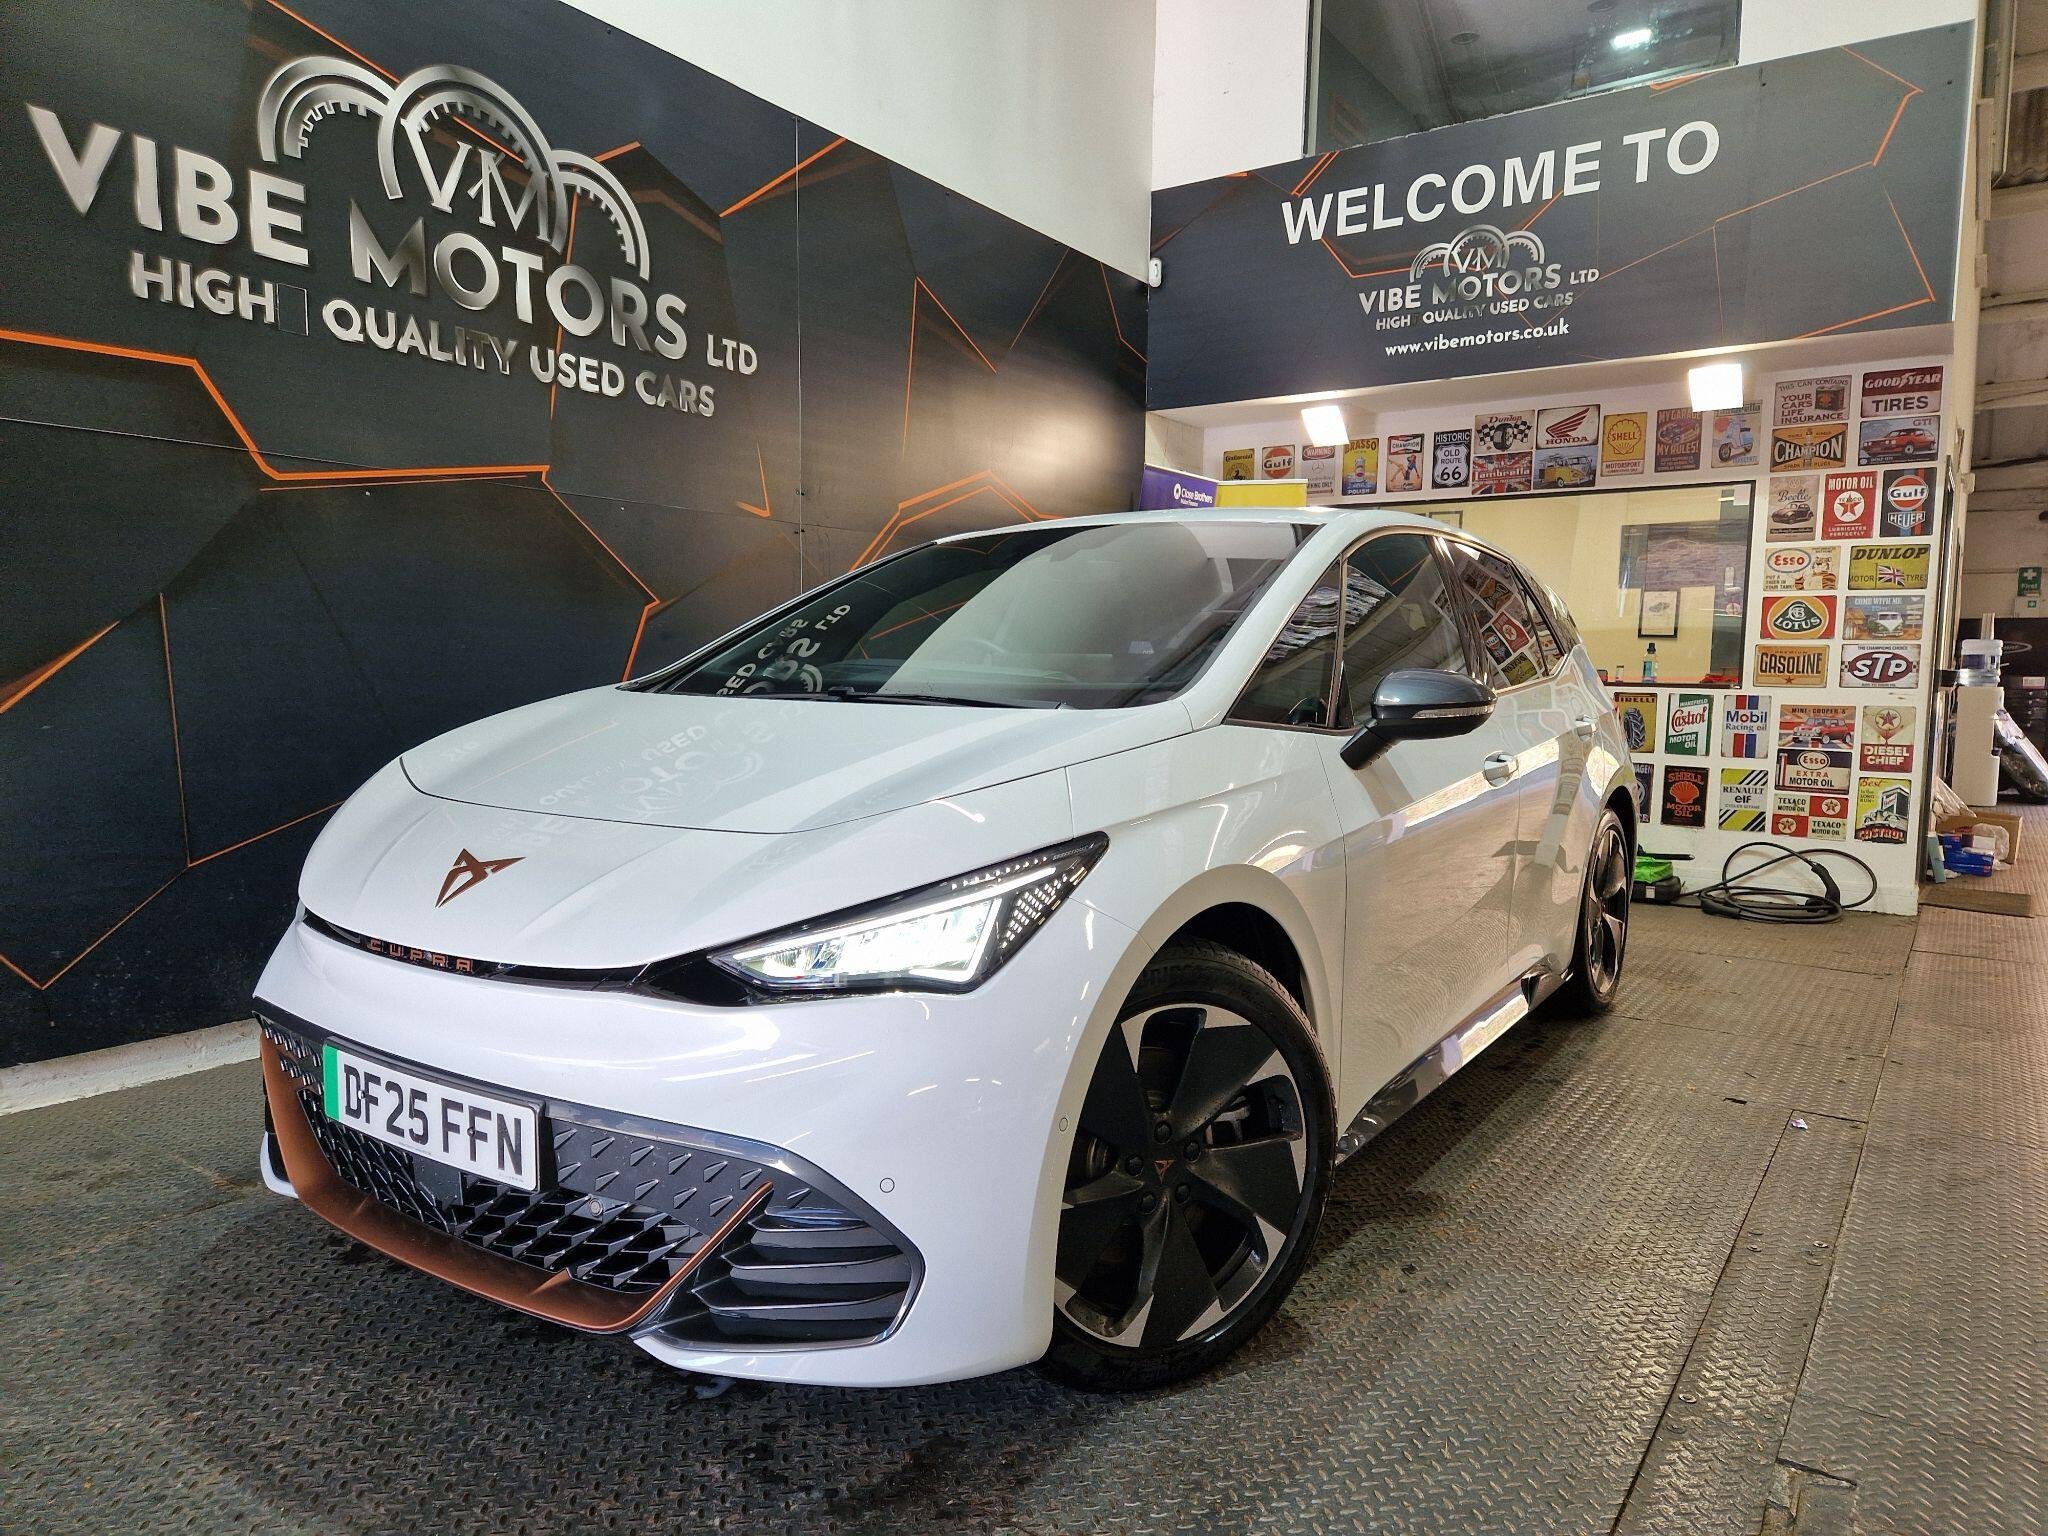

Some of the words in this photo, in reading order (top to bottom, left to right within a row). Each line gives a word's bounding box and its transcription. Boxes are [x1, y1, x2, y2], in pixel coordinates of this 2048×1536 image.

[1281, 139, 1602, 246] WELCOME
[1622, 120, 1720, 183] TO
[26, 102, 310, 266] VIBE
[350, 199, 688, 361] MOTORS
[706, 333, 758, 375] LTD
[1359, 284, 1422, 315] VIBE
[1432, 263, 1563, 306] MOTORS
[1569, 268, 1600, 285] LTD
[1375, 314, 1411, 331] HIGH
[1422, 304, 1486, 324] QUALITY
[1490, 298, 1530, 315] USED
[1534, 292, 1575, 309] CARS
[130, 250, 276, 324] HIGH
[322, 299, 518, 376] QUALITY
[529, 345, 624, 397] USED
[635, 370, 715, 418] CARS
[1385, 317, 1570, 356] www.vibemotors.co.uk
[1779, 383, 1795, 391] THIS
[1797, 380, 1812, 388] CAN
[1815, 378, 1849, 386] CONTAINS
[1865, 372, 1941, 388] GOODYEAR
[1782, 393, 1812, 402] YOUR
[1872, 395, 1928, 412] TIRES
[1658, 410, 1671, 423] MY
[1781, 408, 1804, 417] LIFE
[1781, 412, 1843, 424] INSURANCE
[1488, 414, 1523, 424] Dunlop
[1435, 431, 1471, 443] HISTORIC
[1546, 436, 1589, 445] HONDA
[1612, 431, 1638, 441] SHELL
[1344, 440, 1377, 455] BRASSO
[1392, 441, 1420, 449] CHAMPION
[1657, 443, 1670, 456] MY
[1774, 434, 1843, 463] CHAMPION
[1443, 448, 1460, 457] OLD
[1263, 457, 1293, 469] Gulf
[1441, 457, 1462, 465] ROUTE
[1605, 461, 1641, 469] MOTORSPORT
[1440, 466, 1462, 481] 66
[1828, 477, 1857, 491] MOTOR
[1860, 476, 1873, 489] OIL
[1181, 488, 1194, 500] Close
[1194, 491, 1213, 503] Brothers
[1890, 488, 1926, 499] Gulf
[1890, 511, 1924, 527] HEUER
[1853, 548, 1929, 560] DUNLOP
[1774, 555, 1805, 566] Esso
[1774, 616, 1821, 630] LOTUS
[1759, 652, 1823, 675] GASOLINE
[1853, 653, 1908, 680] STP
[1680, 698, 1709, 707] WAKEFIELD
[1671, 706, 1708, 733] Castrol
[1726, 710, 1768, 723] Mobil
[1725, 723, 1755, 733] Racing
[1756, 723, 1767, 731] oil
[1669, 733, 1697, 744] MOTOR
[1684, 740, 1697, 748] OIL
[1863, 745, 1910, 756] DIESEL
[1803, 755, 1826, 765] Esso
[1866, 755, 1904, 766] CHIEF
[1667, 772, 1704, 785] SHELL
[1796, 770, 1829, 778] EXTRA
[1788, 777, 1818, 787] MOTOR
[1821, 779, 1834, 788] OIL
[1722, 786, 1765, 795] RENAULT
[1734, 794, 1752, 803] elf
[1778, 797, 1806, 805] TEXACO
[1666, 802, 1702, 812] MOTOR
[1812, 820, 1841, 828] TEXACO
[366, 938, 474, 973] CUPRA
[343, 1063, 430, 1146] DF25
[440, 1097, 524, 1177] FFN
